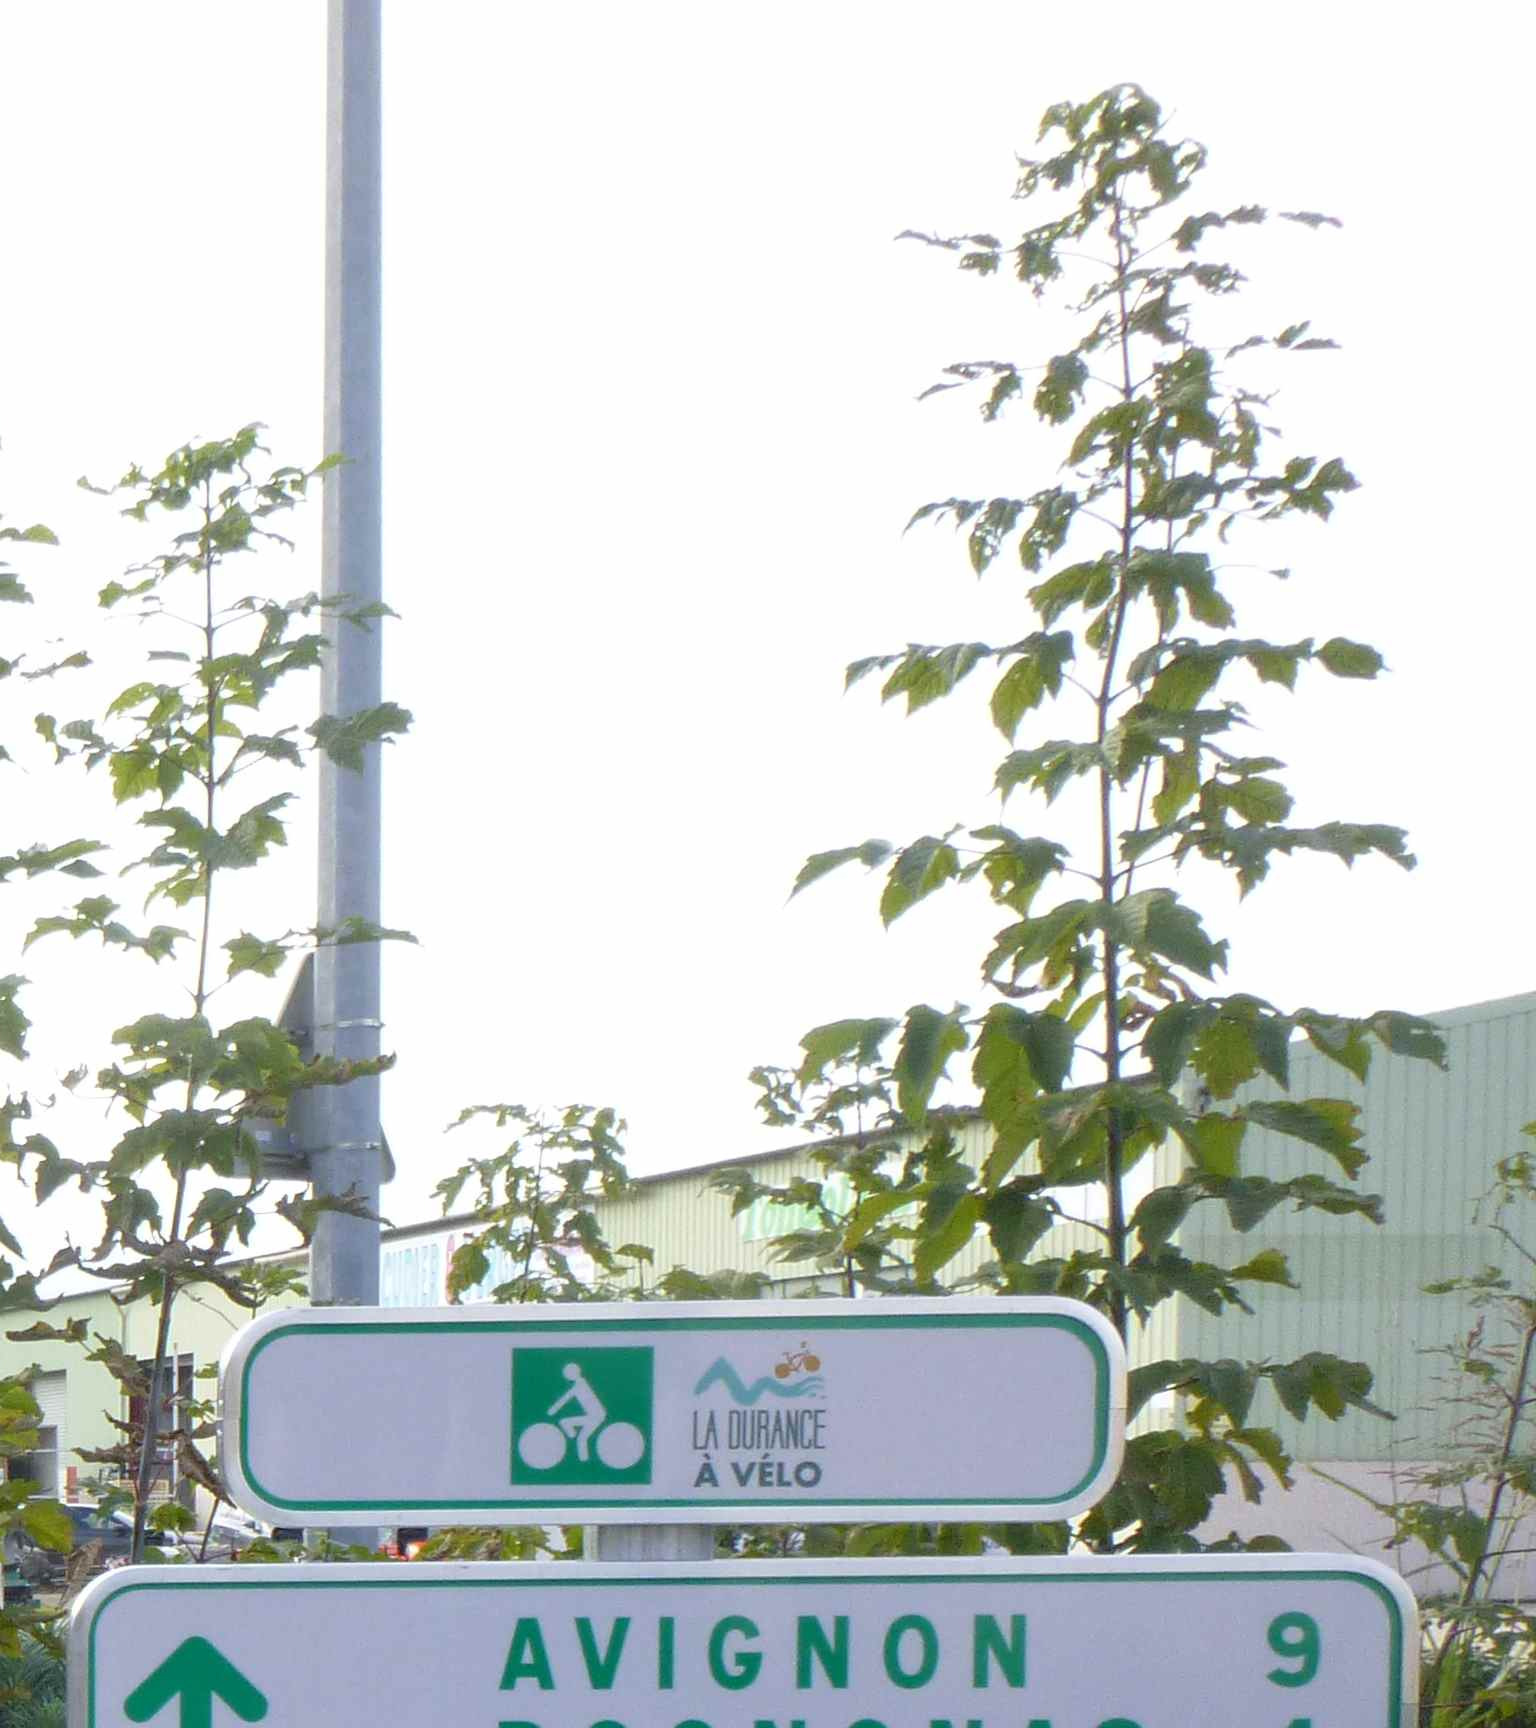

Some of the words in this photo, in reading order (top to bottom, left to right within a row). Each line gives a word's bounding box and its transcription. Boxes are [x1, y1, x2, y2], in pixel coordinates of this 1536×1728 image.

[693, 1409, 719, 1450] LA
[729, 1409, 827, 1450] DURANCE
[693, 1452, 719, 1487] À
[730, 1452, 822, 1488] VÉLO
[500, 1612, 1029, 1691] AVIGNON
[1266, 1610, 1320, 1690] 9
